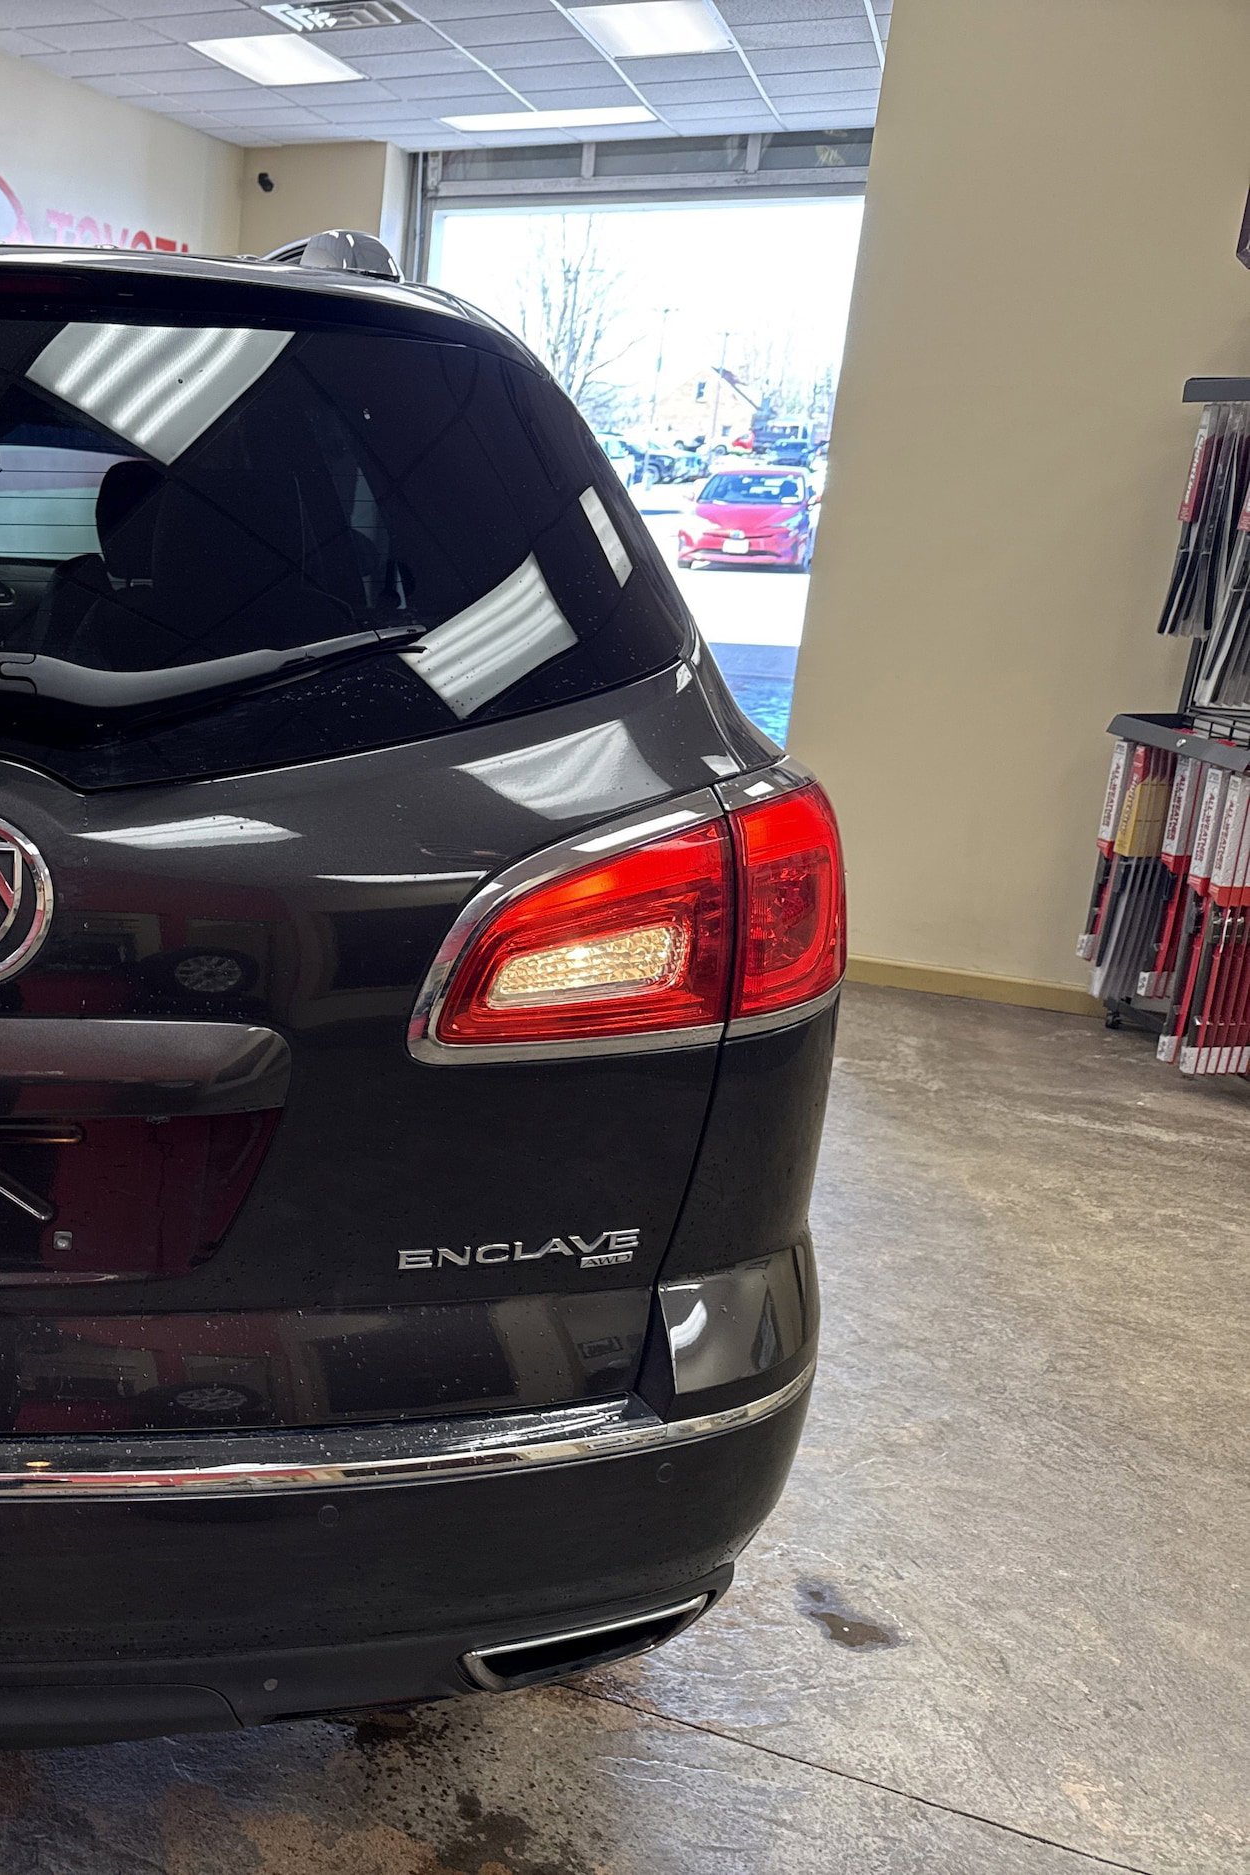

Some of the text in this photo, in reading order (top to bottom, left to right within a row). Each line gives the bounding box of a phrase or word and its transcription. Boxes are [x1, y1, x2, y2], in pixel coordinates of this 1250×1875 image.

[46, 209, 188, 253] TOYO
[1170, 775, 1186, 840] ALL-WEATHER
[1198, 793, 1214, 861] ALL-WEATHER
[398, 1228, 640, 1270] ENCLAVE
[581, 1252, 632, 1268] AWD
